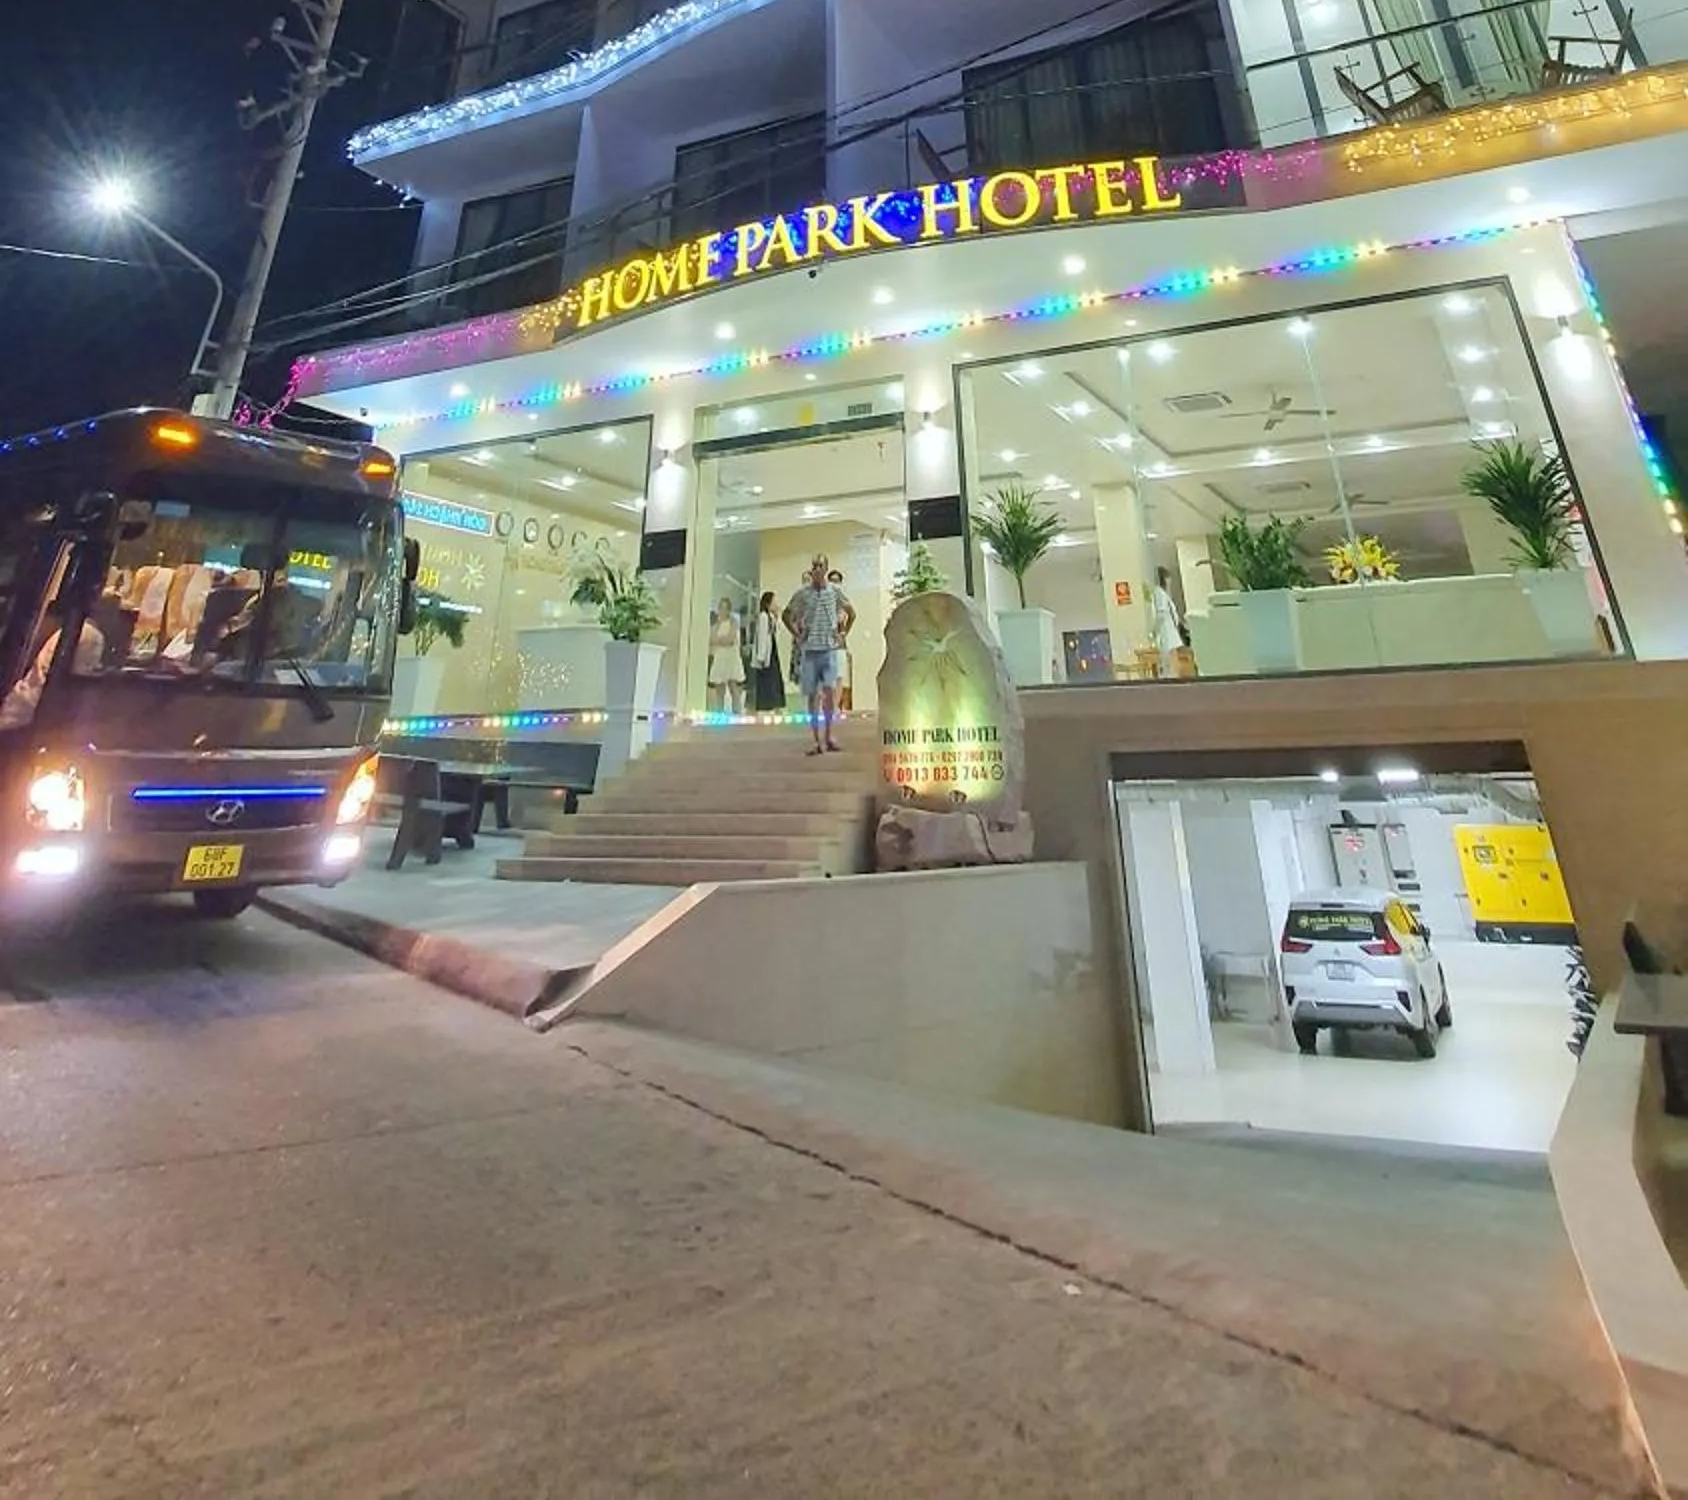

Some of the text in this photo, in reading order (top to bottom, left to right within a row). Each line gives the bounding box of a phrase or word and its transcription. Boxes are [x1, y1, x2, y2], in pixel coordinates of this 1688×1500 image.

[577, 155, 1182, 328] HOME PARK HOTEL
[922, 727, 953, 743] PARK
[957, 725, 1000, 742] HOTEL
